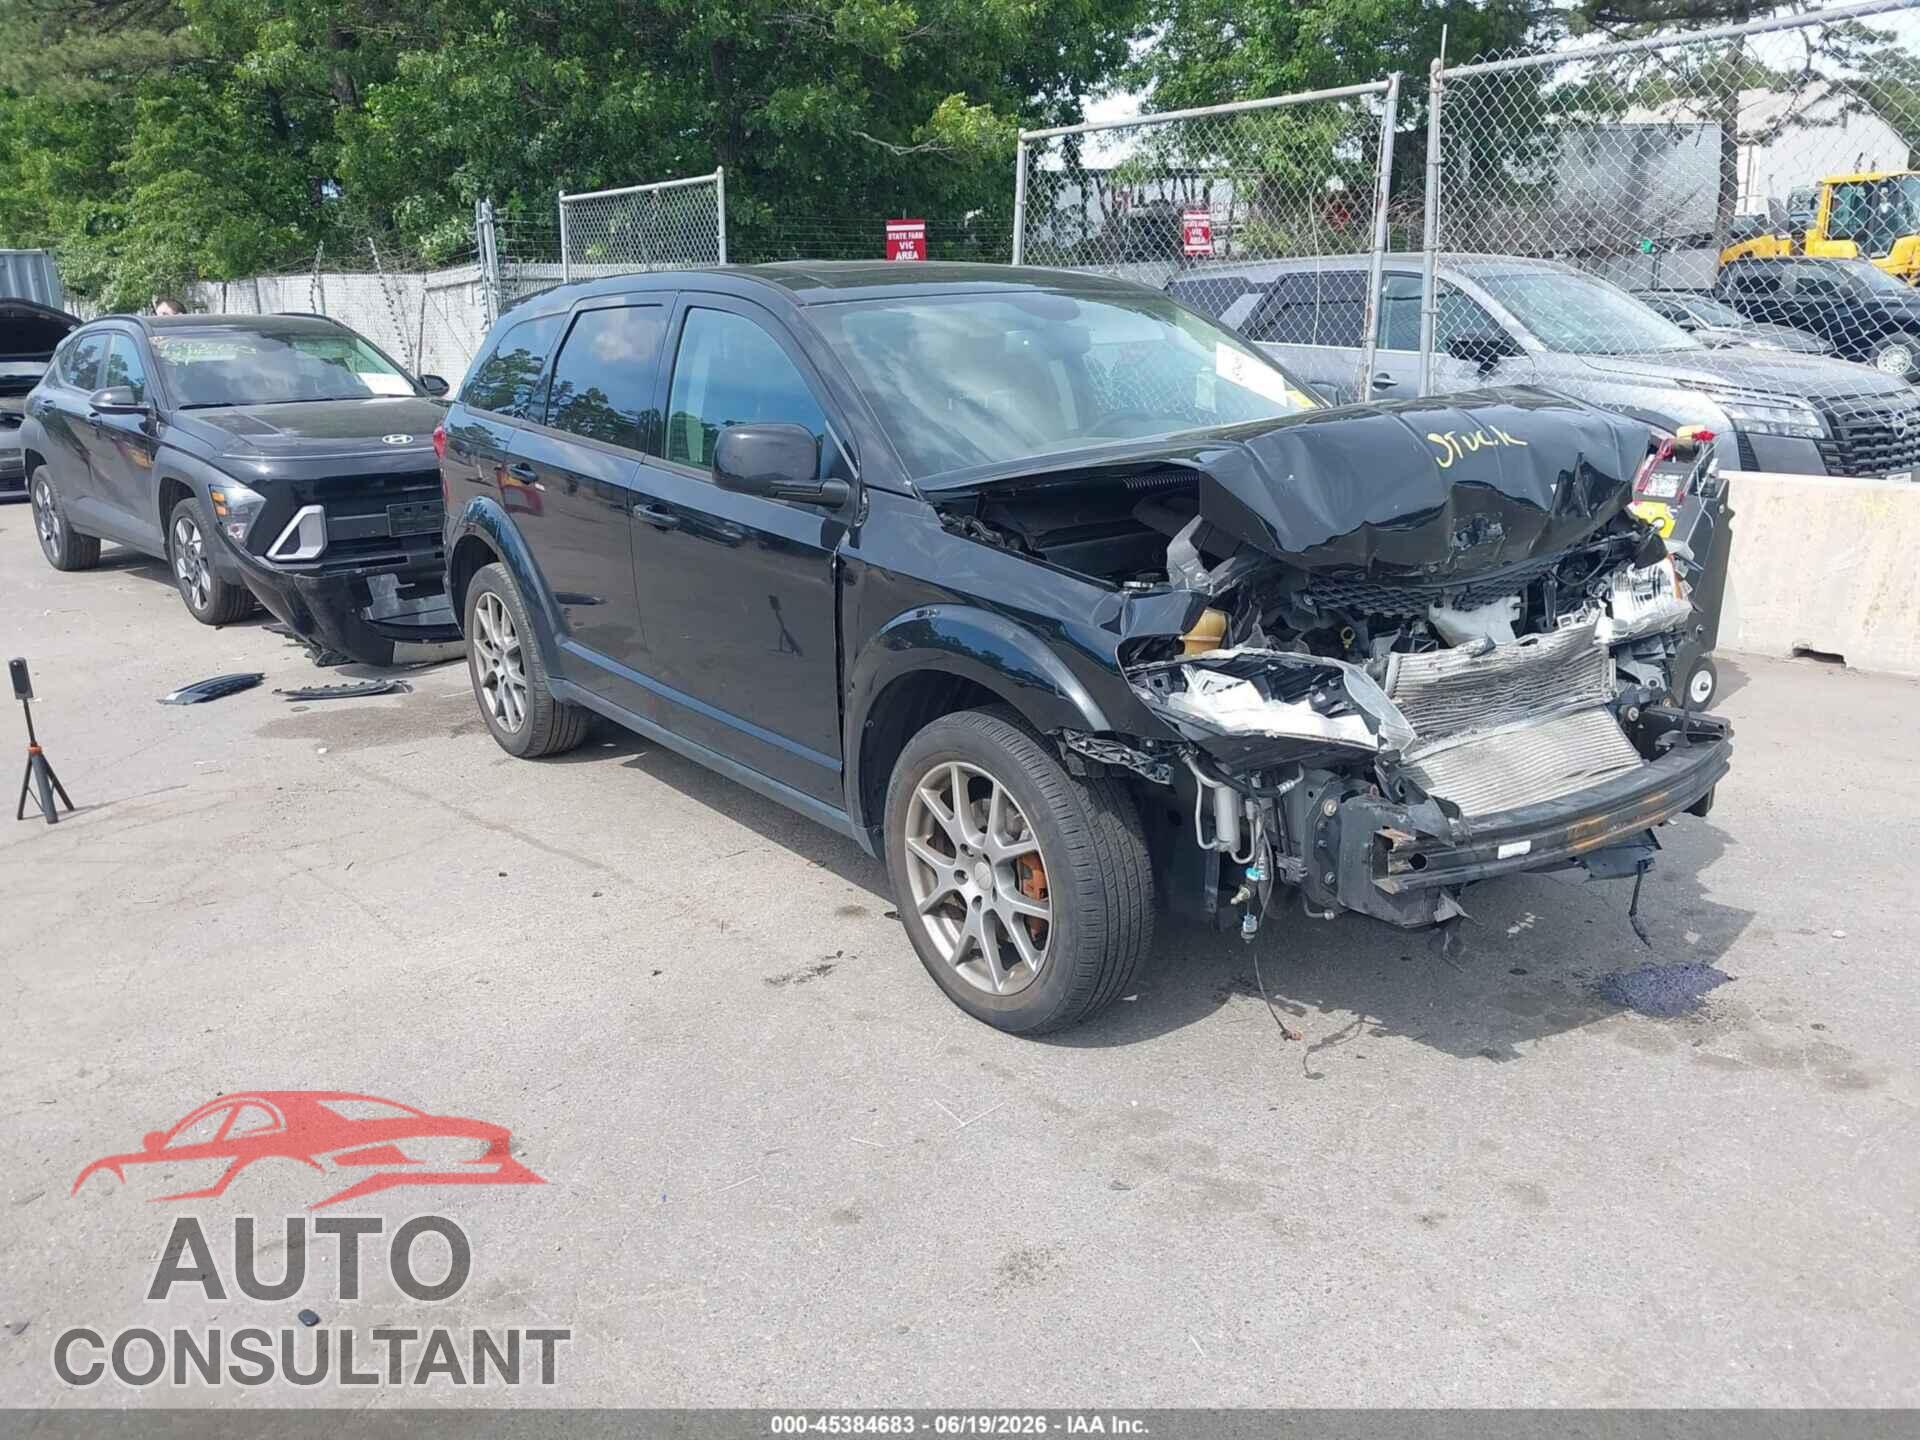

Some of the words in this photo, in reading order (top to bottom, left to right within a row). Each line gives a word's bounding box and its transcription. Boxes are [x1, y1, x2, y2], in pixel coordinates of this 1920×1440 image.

[888, 232, 907, 240] STATE
[899, 240, 914, 250] VIC
[896, 250, 919, 260] AREA
